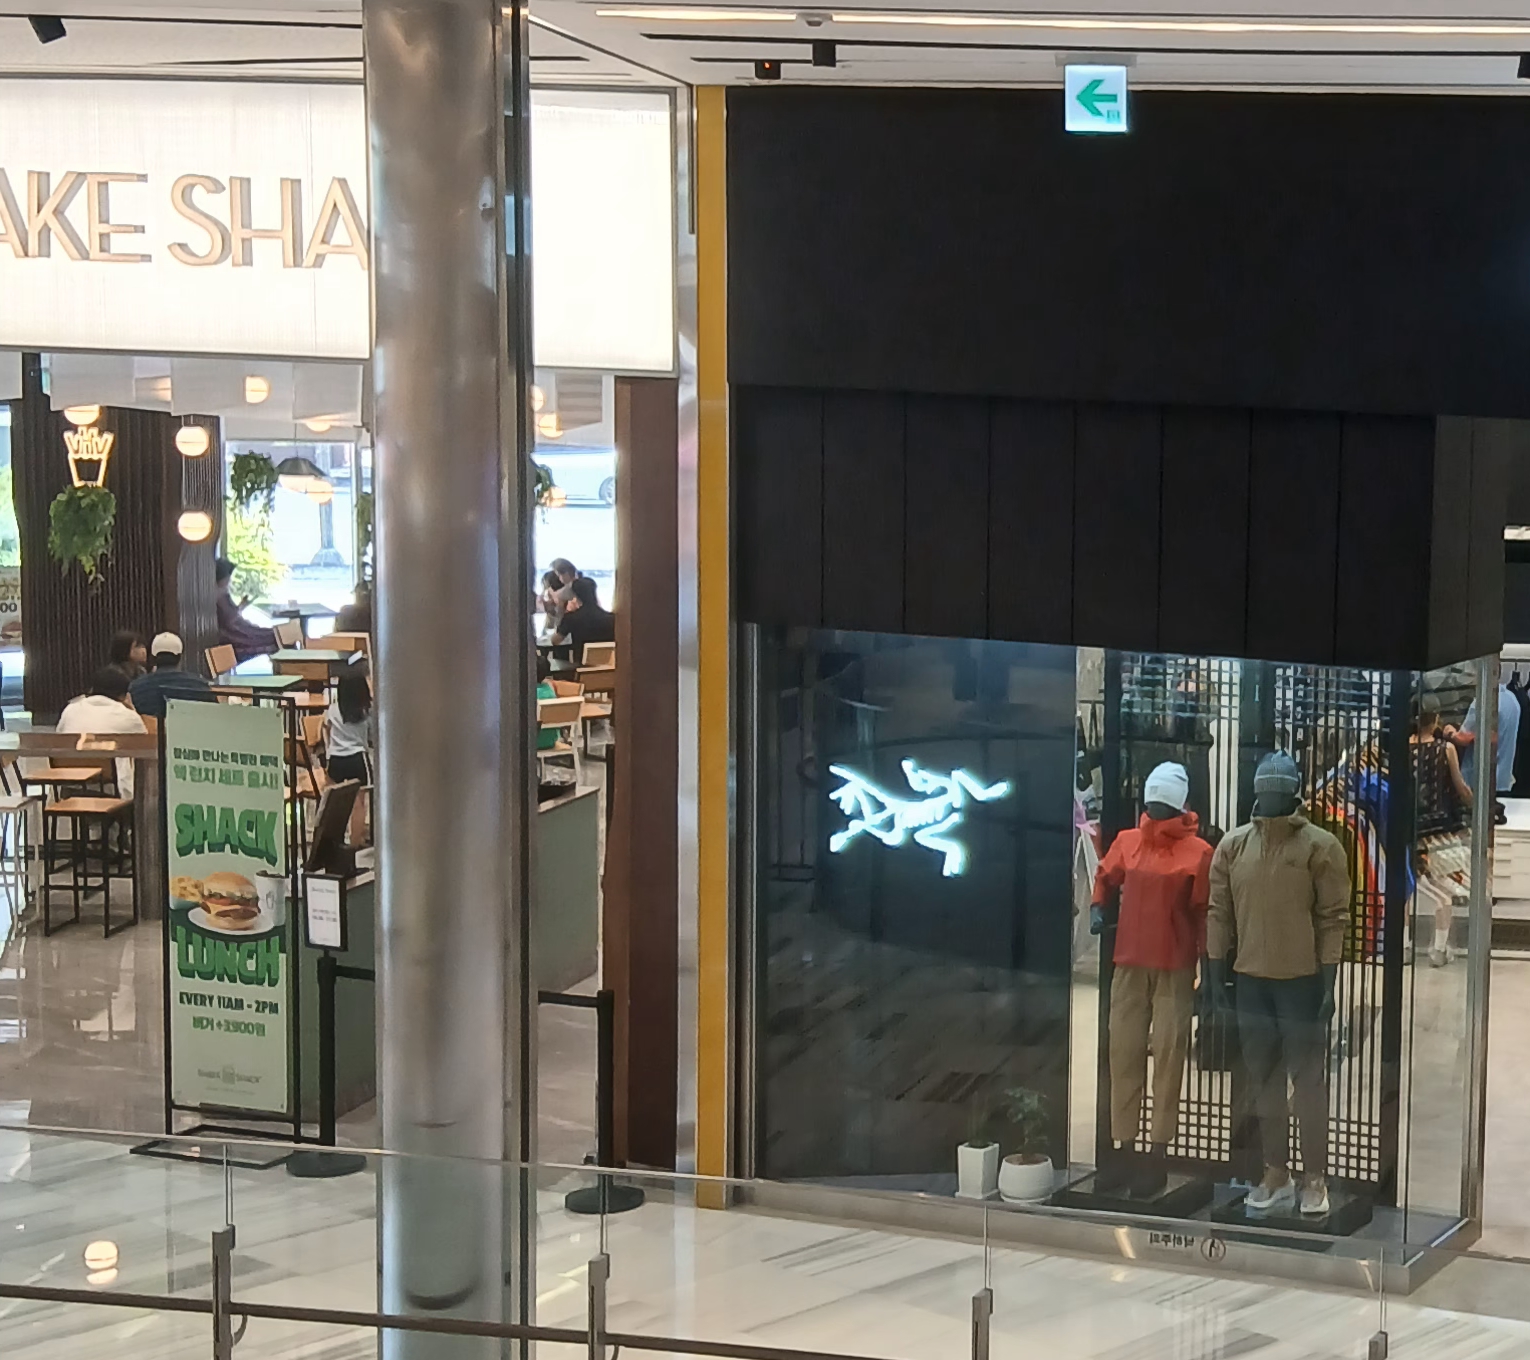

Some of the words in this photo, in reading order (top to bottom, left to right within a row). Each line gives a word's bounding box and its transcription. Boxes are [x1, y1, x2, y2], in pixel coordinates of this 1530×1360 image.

[167, 173, 368, 271] SHA
[175, 803, 279, 867] SHACK
[176, 924, 280, 988] LUNCH
[178, 991, 214, 1008] EVERY
[216, 995, 244, 1011] 11AM
[254, 1000, 279, 1015] 2PM
